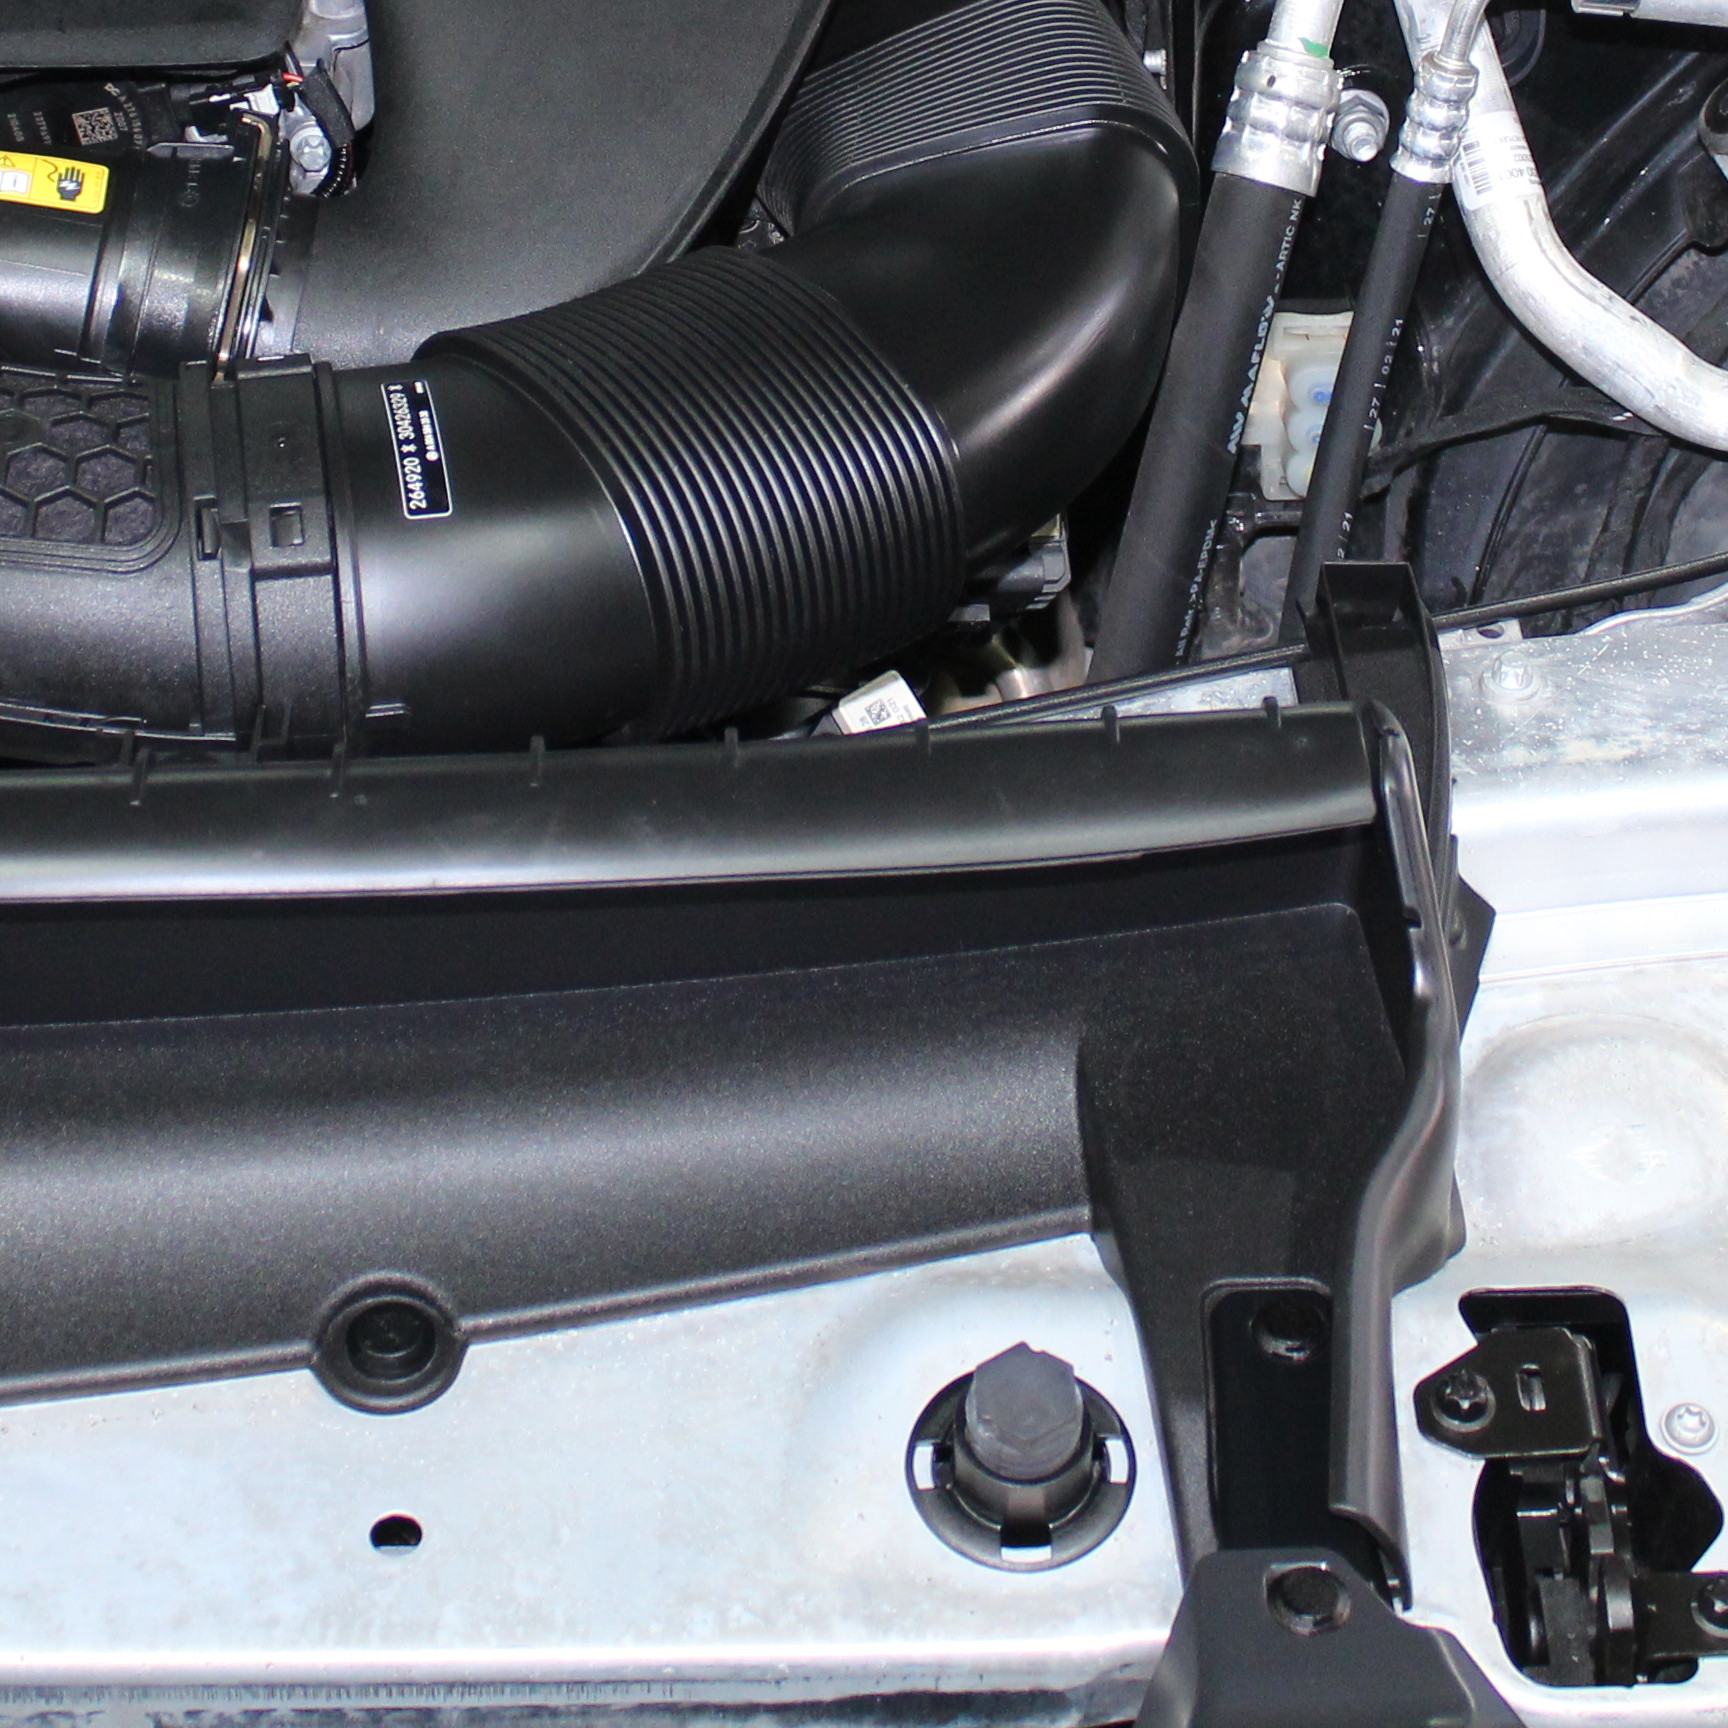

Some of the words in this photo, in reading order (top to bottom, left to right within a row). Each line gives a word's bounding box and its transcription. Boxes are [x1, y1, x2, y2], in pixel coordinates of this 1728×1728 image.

[1276, 225, 1295, 271] ARTIC
[1289, 198, 1302, 221] NK
[1367, 396, 1382, 418] 27
[1379, 353, 1393, 375] 02
[1390, 316, 1404, 337] 21
[404, 457, 427, 510] 264920
[1339, 511, 1354, 531] 21
